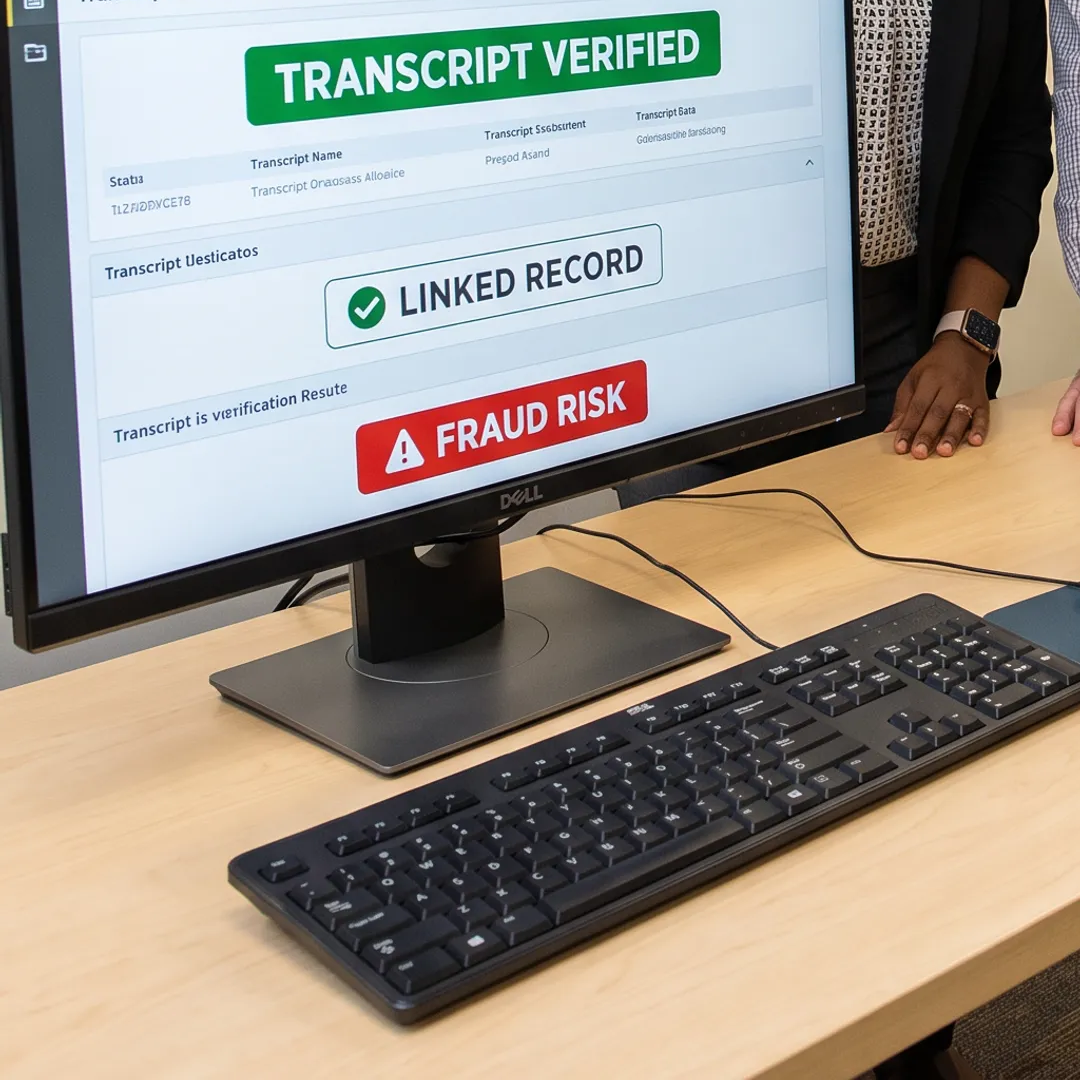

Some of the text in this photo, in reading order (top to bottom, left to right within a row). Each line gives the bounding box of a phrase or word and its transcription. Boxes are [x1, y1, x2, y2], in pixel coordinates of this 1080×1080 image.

[274, 28, 700, 104] TRANSCRIPT VERIFIED
[636, 107, 677, 121] Transcript
[484, 125, 533, 141] Transcript
[250, 149, 343, 170] Transcript Name
[250, 181, 308, 198] Transcript
[104, 257, 182, 280] Transcript
[399, 243, 644, 317] LINKED RECORD
[113, 415, 192, 443] Transcript
[196, 411, 208, 426] is
[301, 382, 348, 403] Resute
[435, 380, 628, 458] FRAUD RISK
[500, 485, 544, 510] DELL
